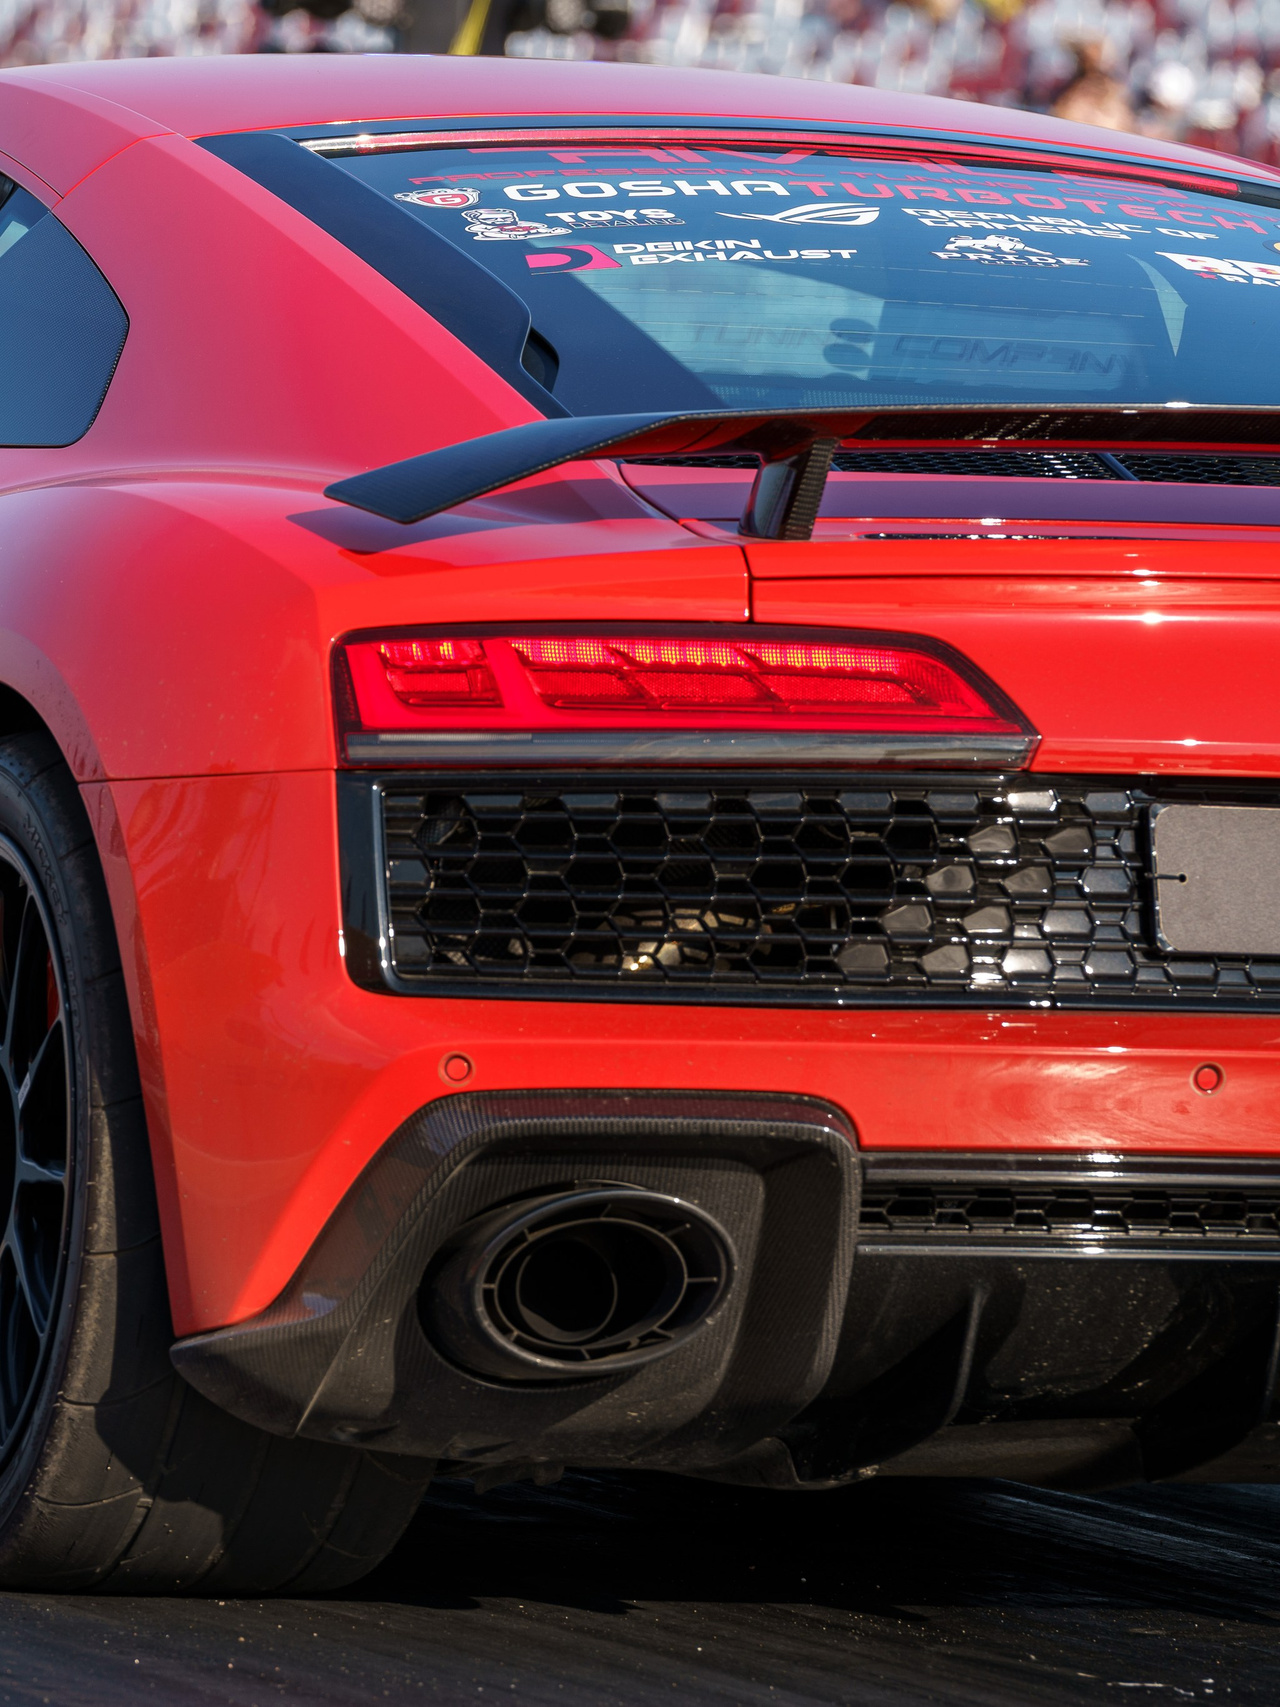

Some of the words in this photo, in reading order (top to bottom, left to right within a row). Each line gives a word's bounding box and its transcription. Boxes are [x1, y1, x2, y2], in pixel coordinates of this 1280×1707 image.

[408, 168, 826, 185] PROFESSIONAL
[544, 208, 676, 223] TOYS
[568, 217, 686, 229] DETAILING
[901, 207, 1152, 234] REPUBLIC
[1155, 227, 1220, 241] OF
[917, 217, 1132, 240] GAMERS
[629, 250, 858, 265] EXHAUST
[931, 251, 1093, 267] PRIDE
